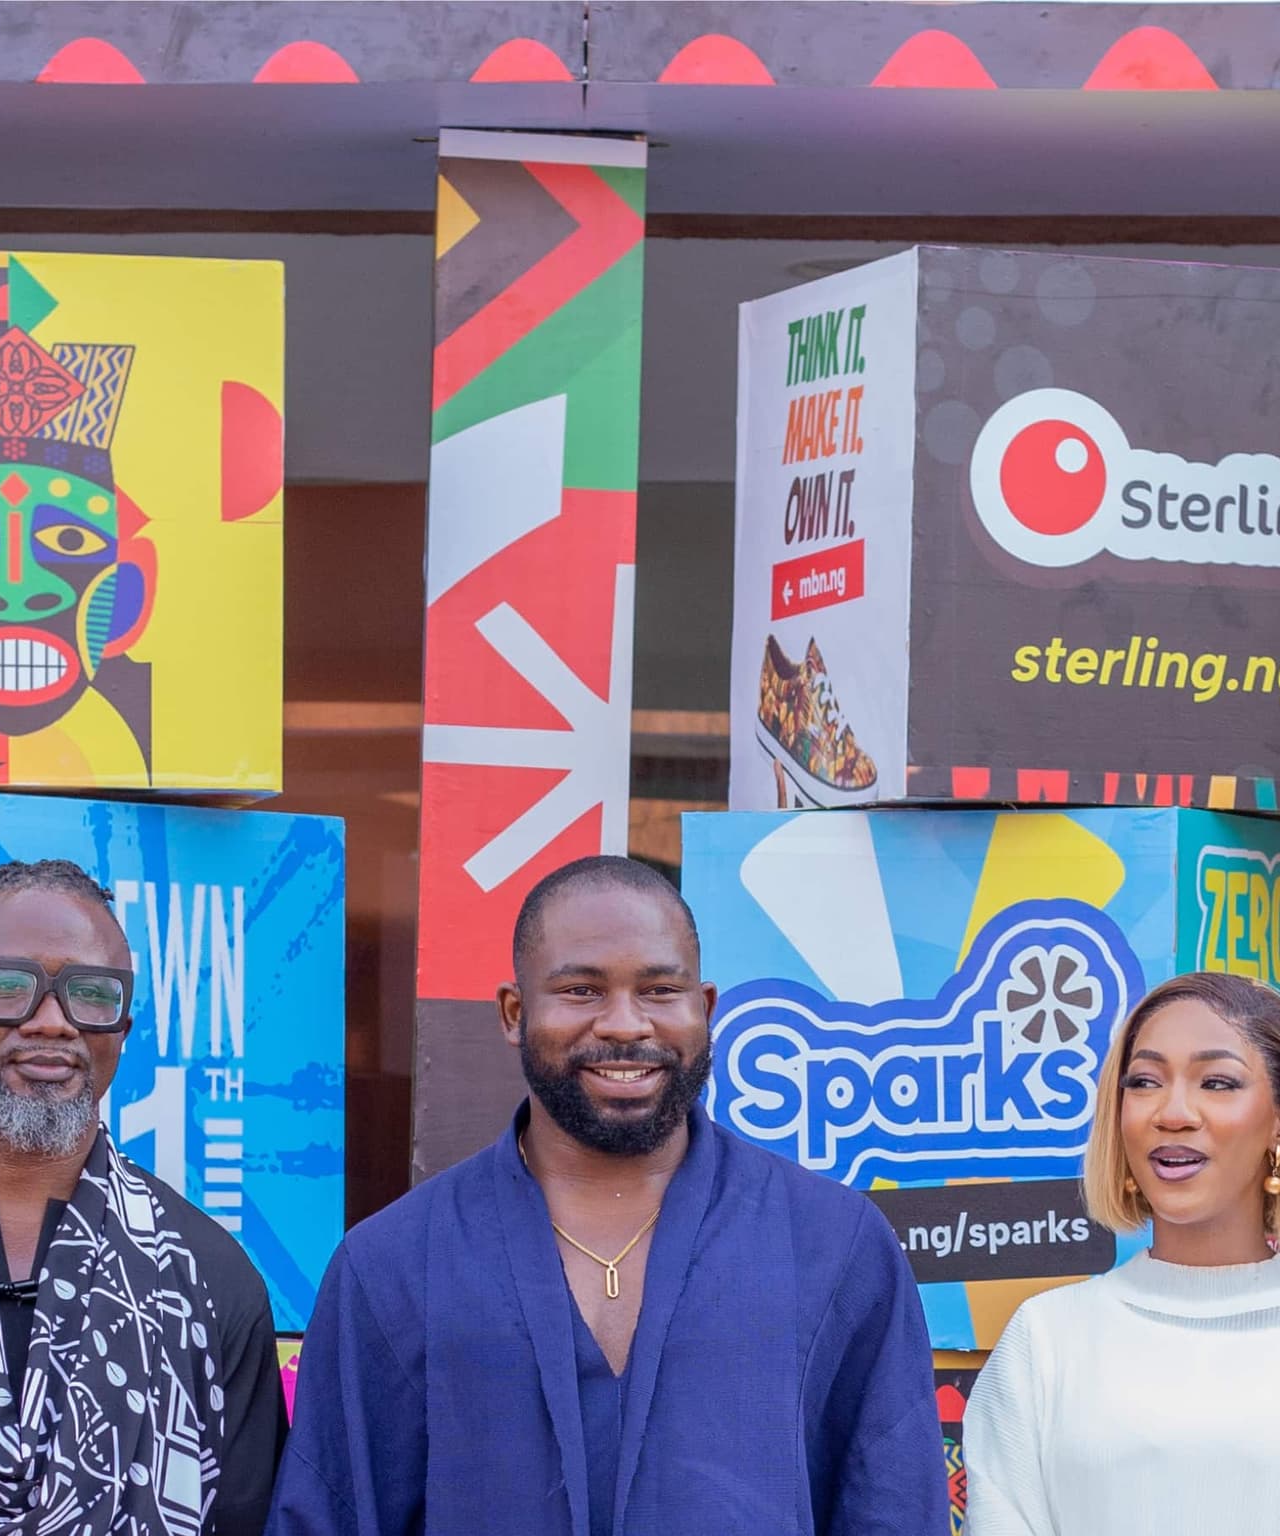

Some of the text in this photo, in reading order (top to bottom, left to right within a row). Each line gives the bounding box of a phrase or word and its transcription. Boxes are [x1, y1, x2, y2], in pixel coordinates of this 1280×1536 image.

[786, 304, 866, 387] THINK IT.
[782, 385, 864, 465] MAKE IT.
[784, 468, 856, 545] OWN IT.
[799, 566, 846, 600] mbn.ng
[738, 1021, 1089, 1159] Sparks
[896, 1210, 1090, 1257] .ng/sparks
